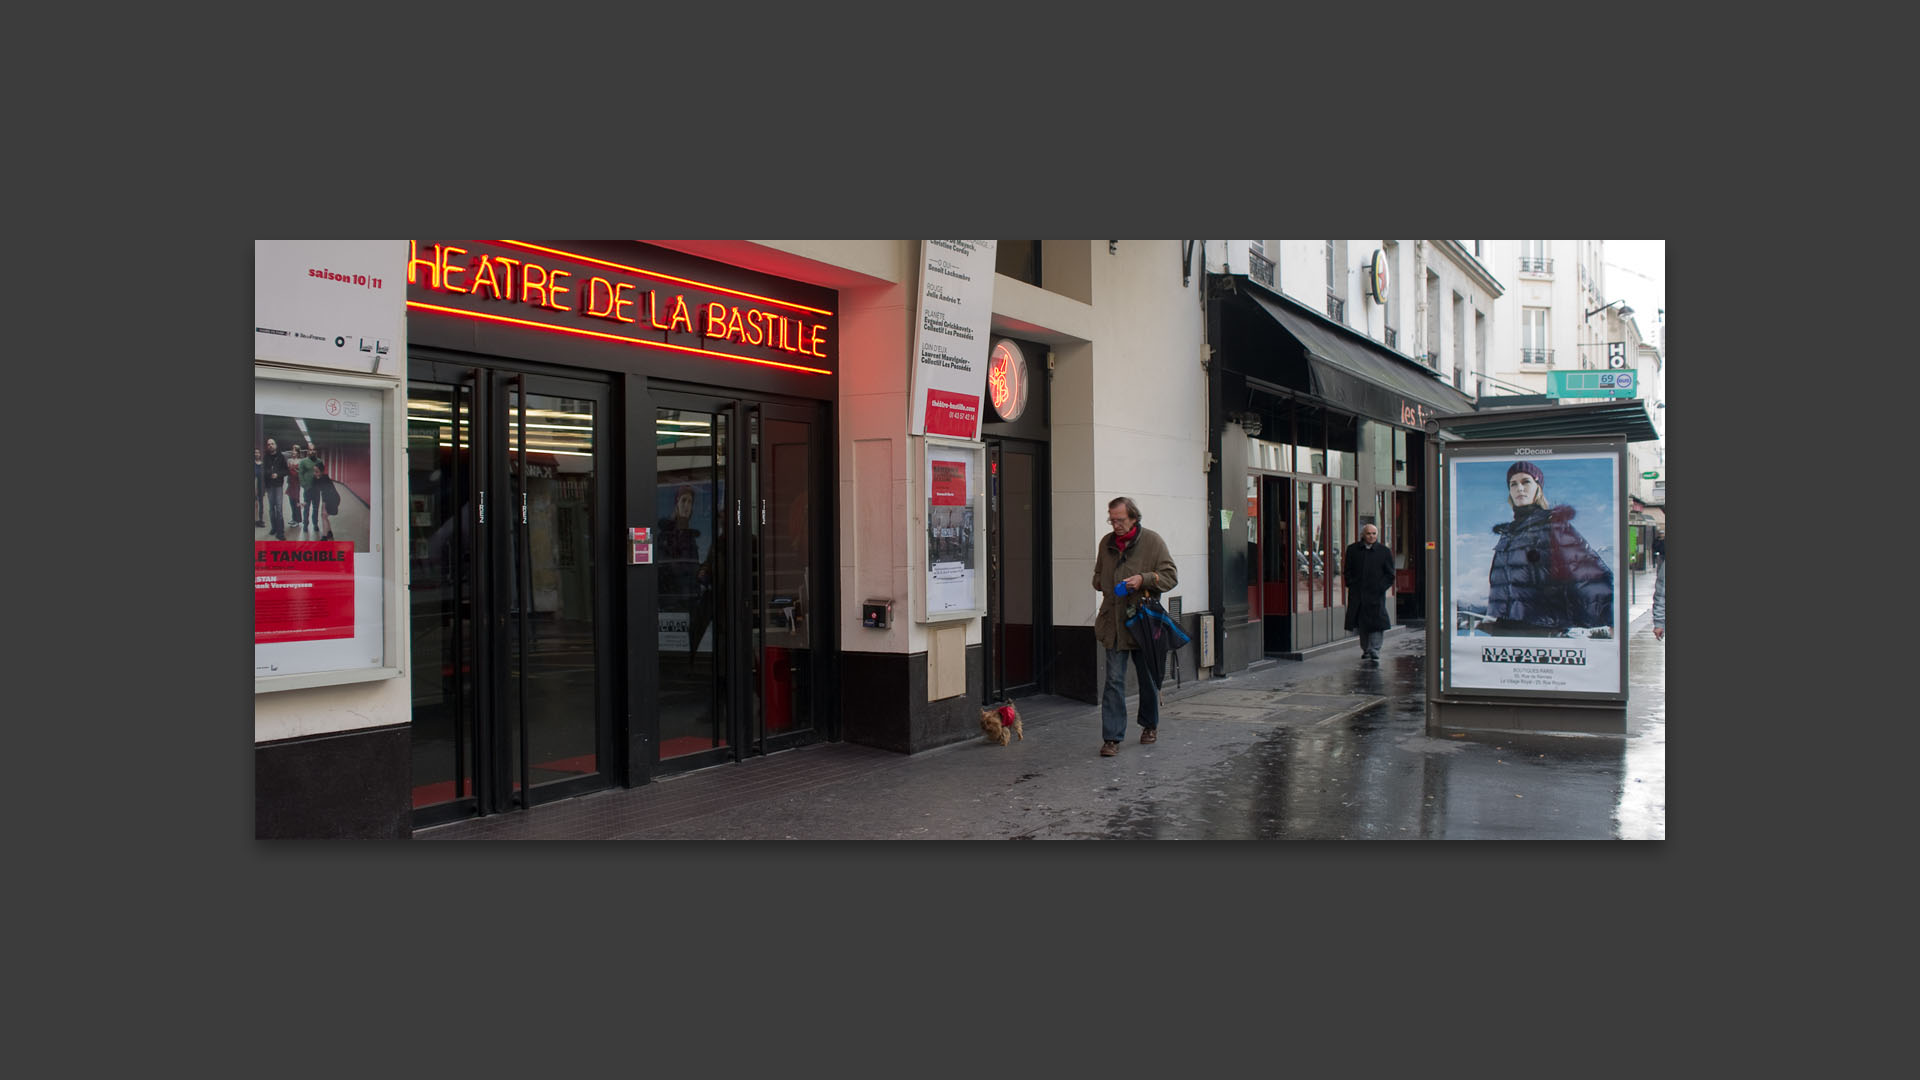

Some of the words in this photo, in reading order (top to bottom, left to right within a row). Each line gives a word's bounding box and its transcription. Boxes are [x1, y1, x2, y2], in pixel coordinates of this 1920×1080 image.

[308, 268, 351, 283] saison
[926, 282, 943, 293] ROUGE
[587, 276, 636, 323] DE
[650, 289, 693, 333] LA
[706, 301, 828, 358] BASTILLE
[944, 328, 953, 336] Les
[921, 342, 933, 351] LOIN
[921, 350, 941, 360] Laurent
[921, 357, 942, 367] Collectif
[942, 360, 951, 368] Les
[1601, 374, 1614, 383] 69
[1401, 399, 1416, 426] les
[1514, 447, 1553, 455] JCDecaux
[270, 550, 345, 563] TANGIBLE
[1484, 646, 1585, 666] NAPAPIJRI
